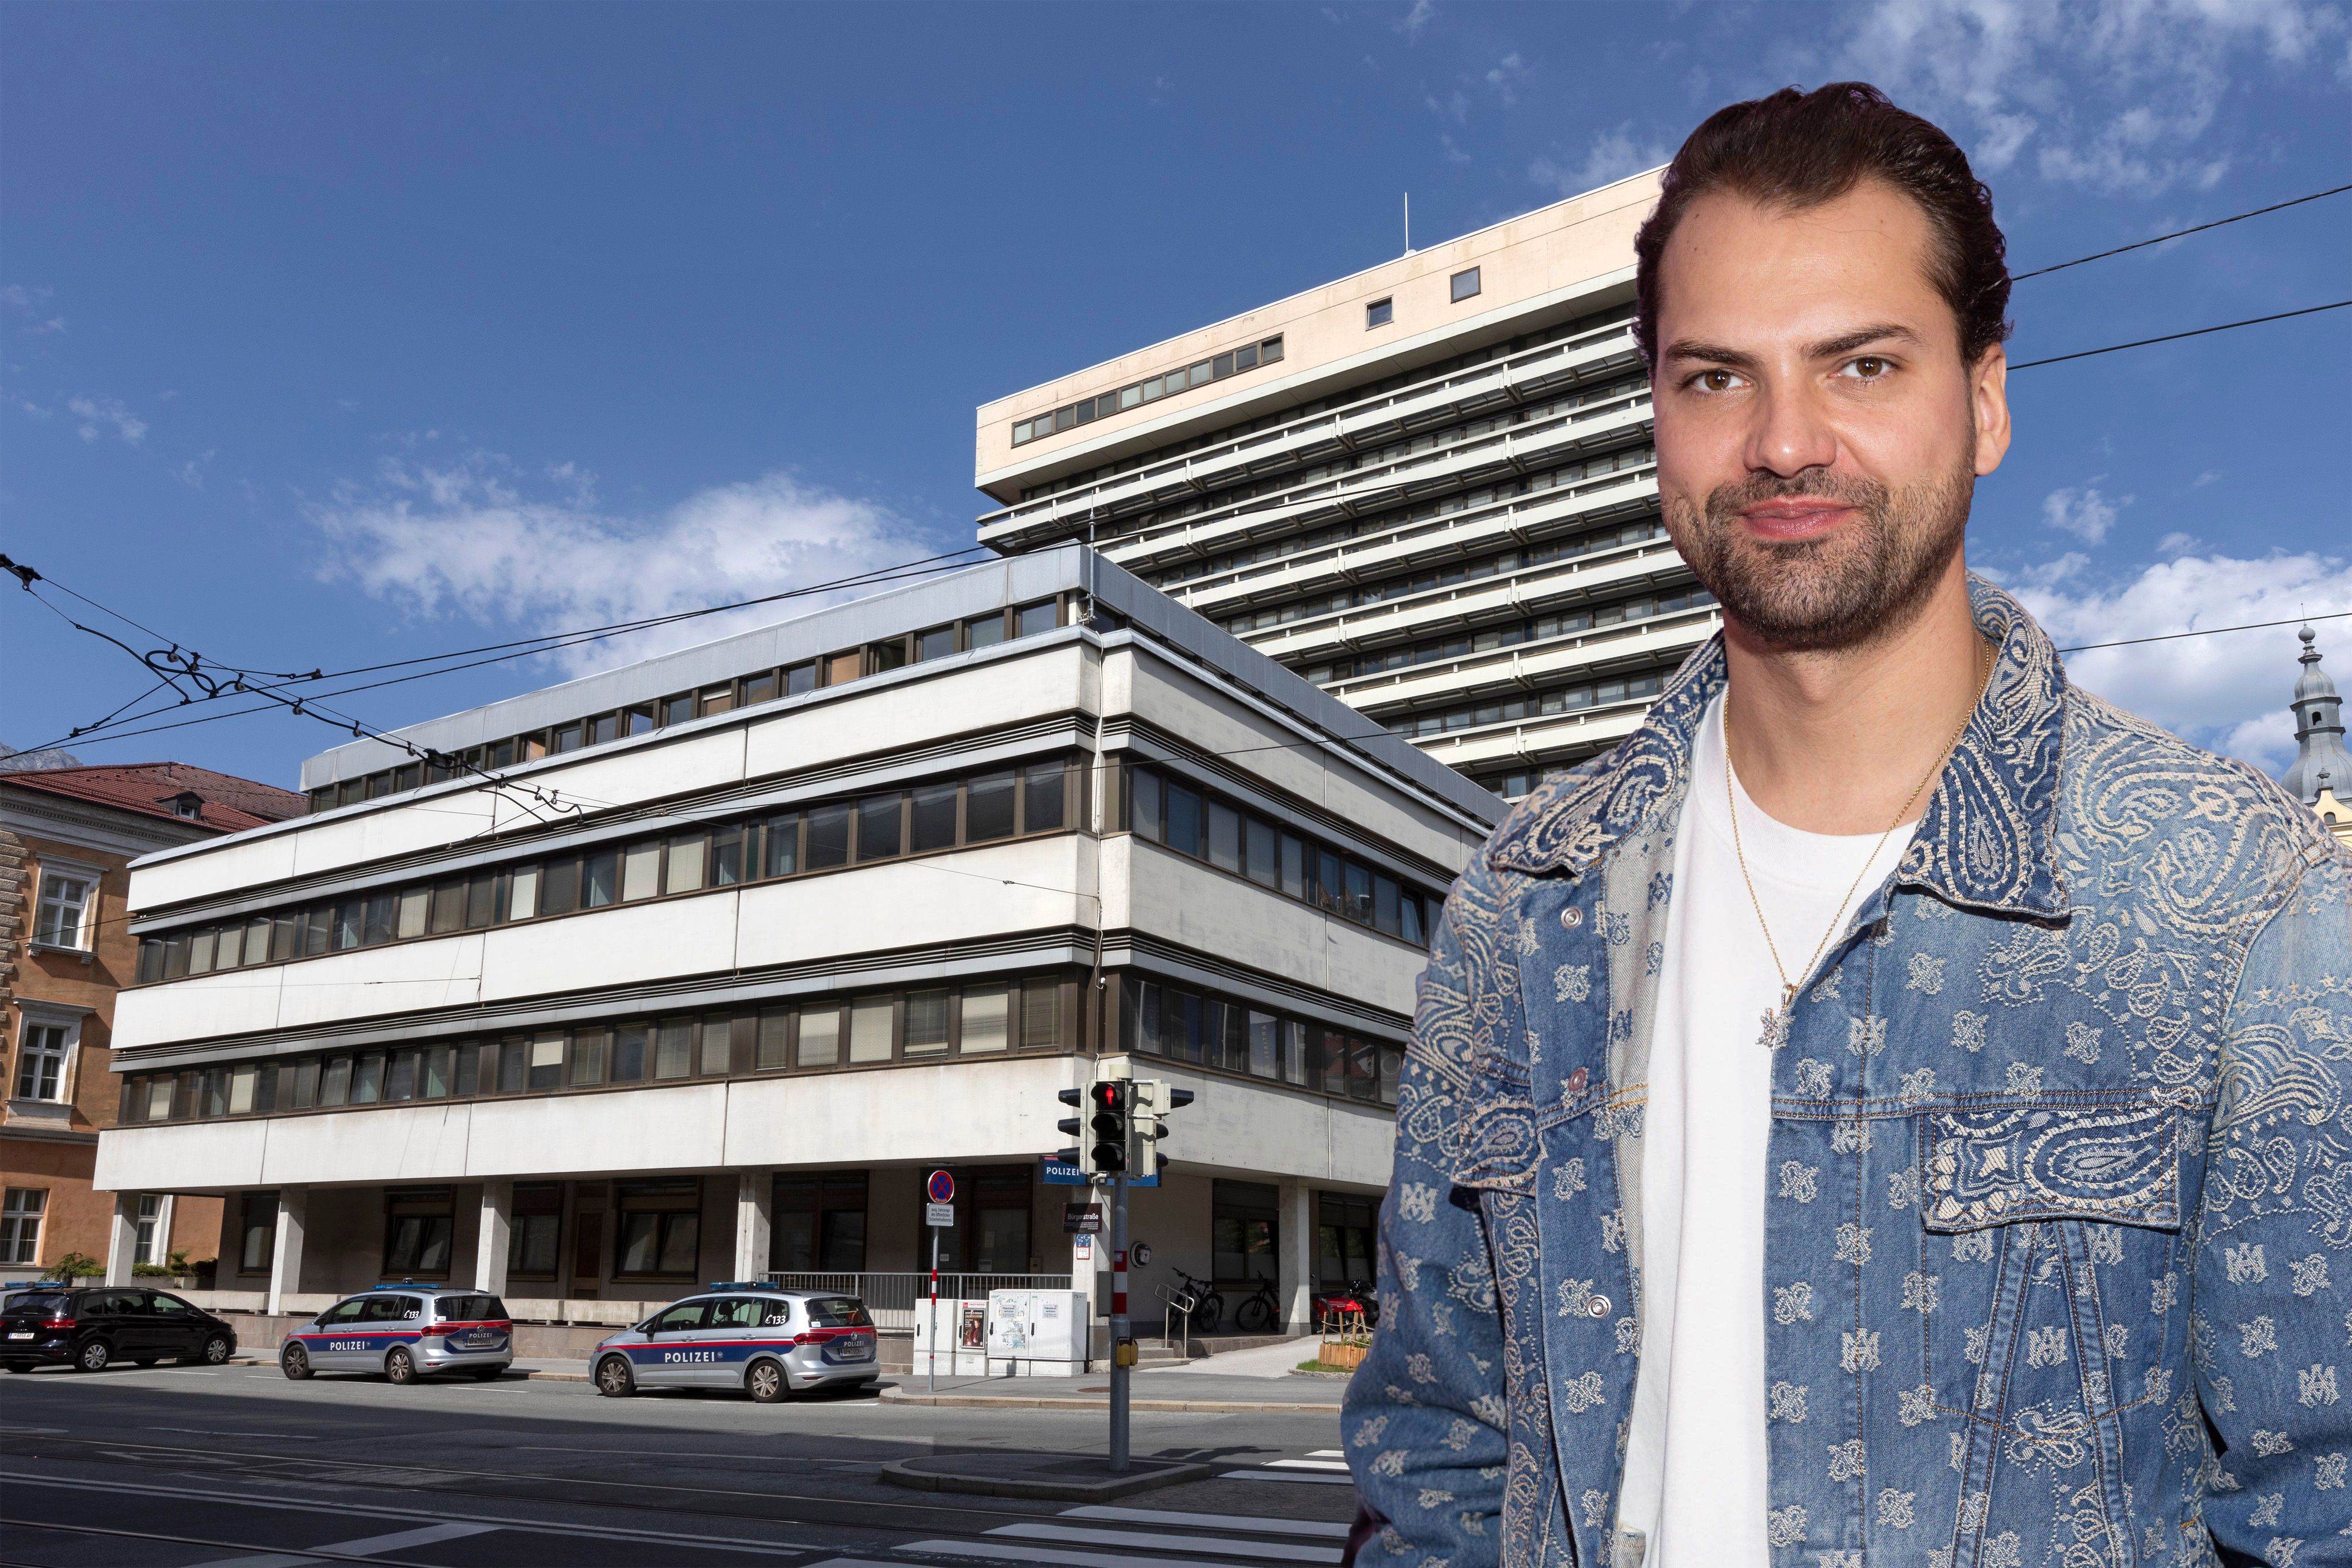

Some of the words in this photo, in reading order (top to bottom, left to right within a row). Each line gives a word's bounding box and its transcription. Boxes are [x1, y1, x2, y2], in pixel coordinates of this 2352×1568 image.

[1046, 1166, 1080, 1176] POLIZEI
[1067, 1213, 1098, 1221] Bürgerstraße
[409, 1310, 419, 1319] 133
[772, 1315, 786, 1325] 133
[330, 1341, 365, 1350] POLIZEI
[664, 1352, 715, 1363] POLIZEI
